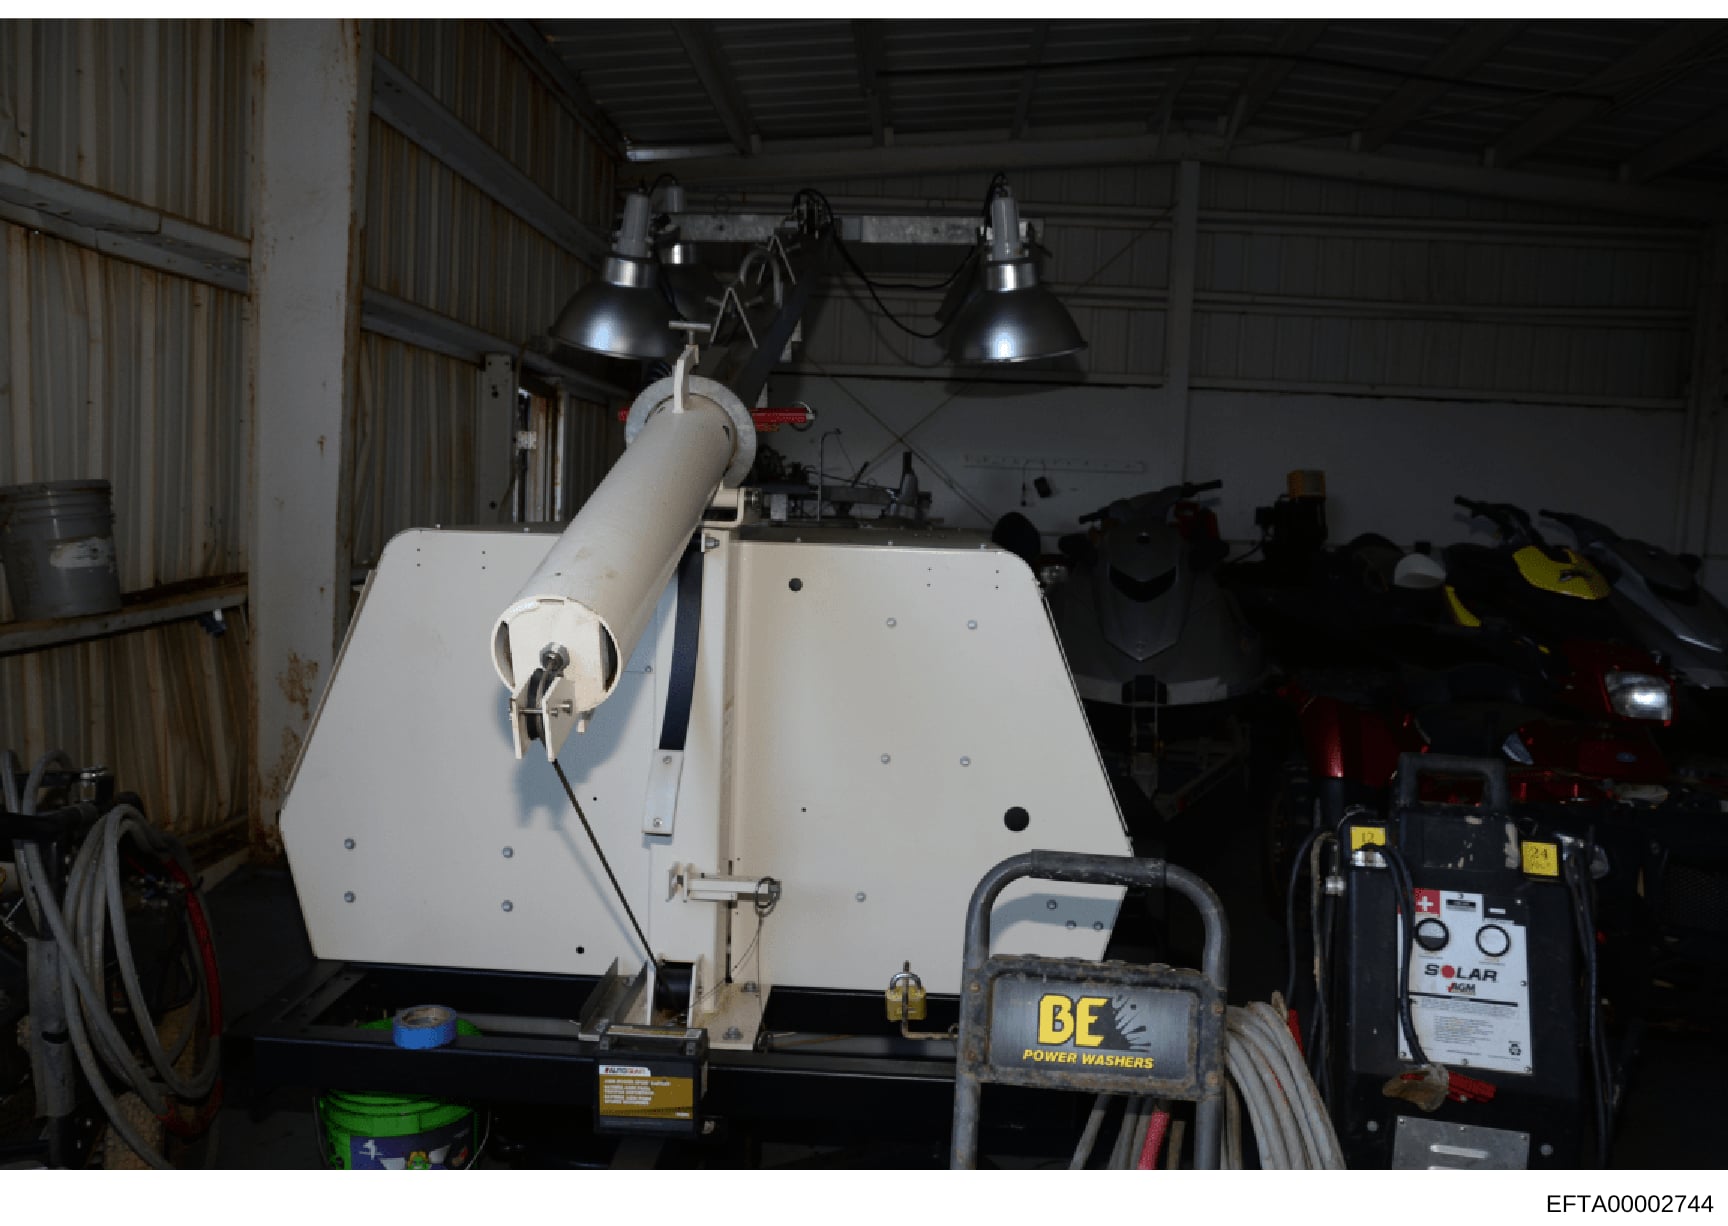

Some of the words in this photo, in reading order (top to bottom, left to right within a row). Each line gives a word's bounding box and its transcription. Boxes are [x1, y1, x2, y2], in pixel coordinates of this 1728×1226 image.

[1531, 847, 1548, 859] 24
[1425, 964, 1497, 982] SOLAR
[1038, 993, 1110, 1048] BE
[1023, 1049, 1078, 1064] POWER
[1082, 1052, 1155, 1069] WASHERS
